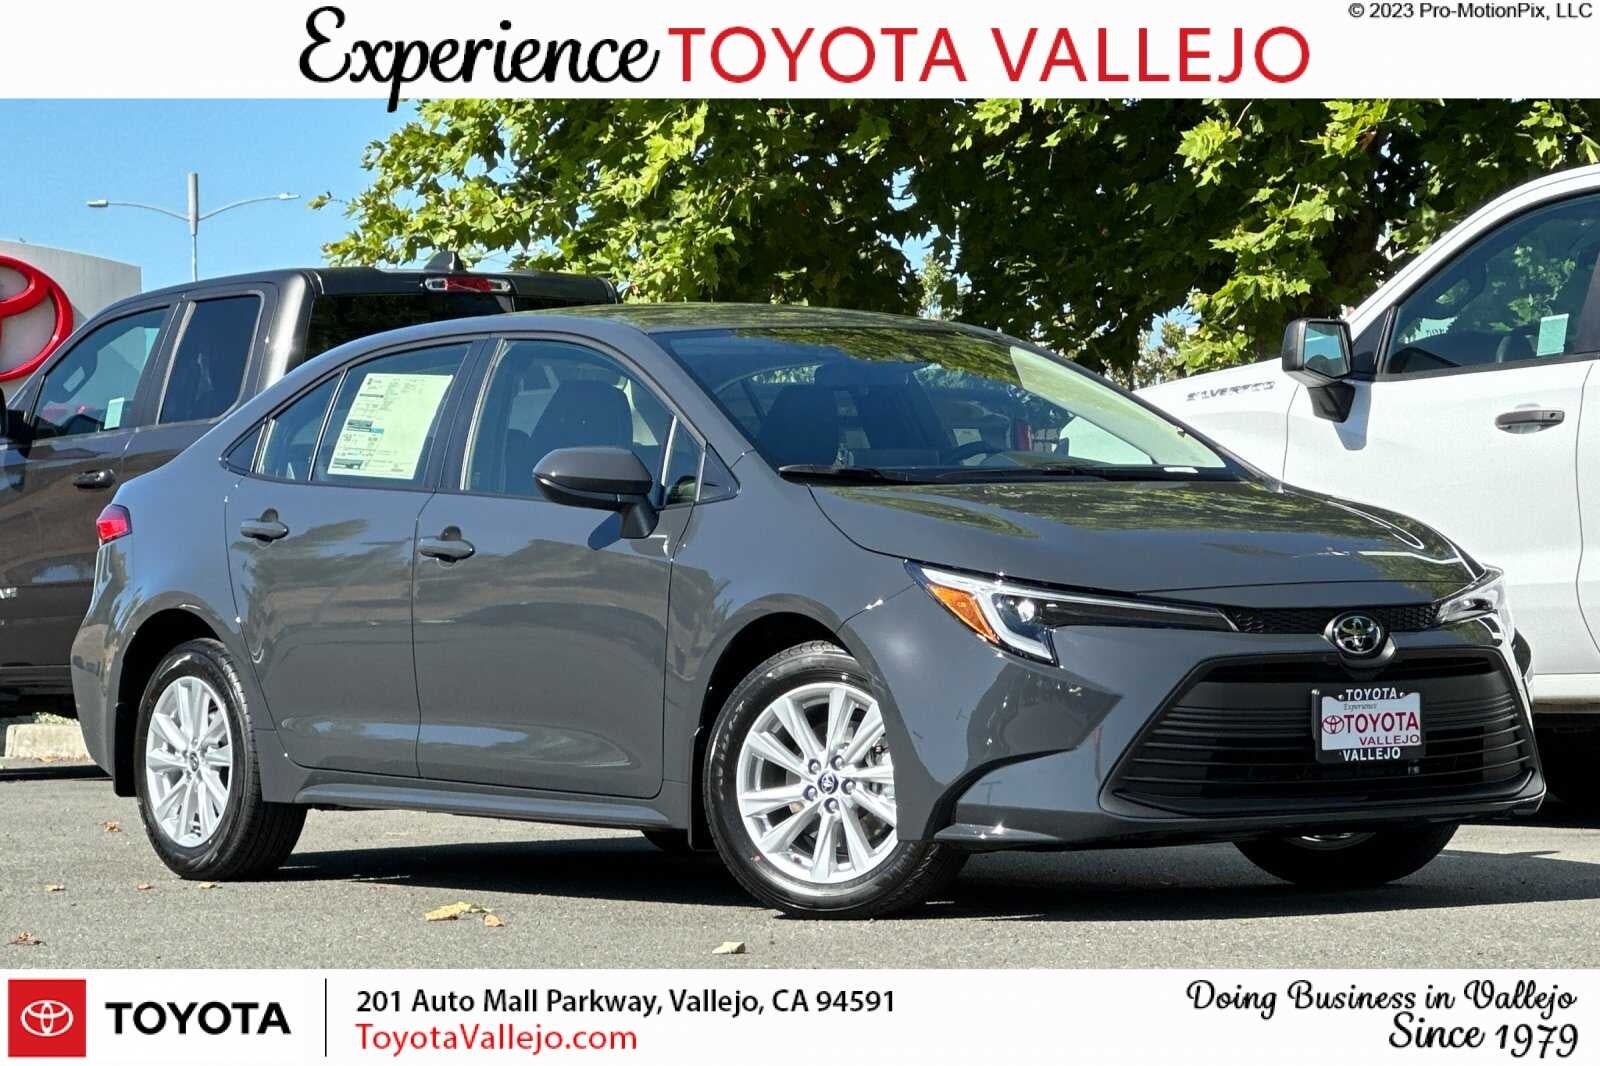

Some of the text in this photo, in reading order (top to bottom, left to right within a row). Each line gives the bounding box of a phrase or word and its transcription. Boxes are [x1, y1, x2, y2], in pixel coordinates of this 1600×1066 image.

[1346, 687, 1397, 700] TOYOTA
[1344, 711, 1419, 734] TOYOTA
[1359, 734, 1420, 746] VALLEJO
[1342, 747, 1401, 761] VALLEJO
